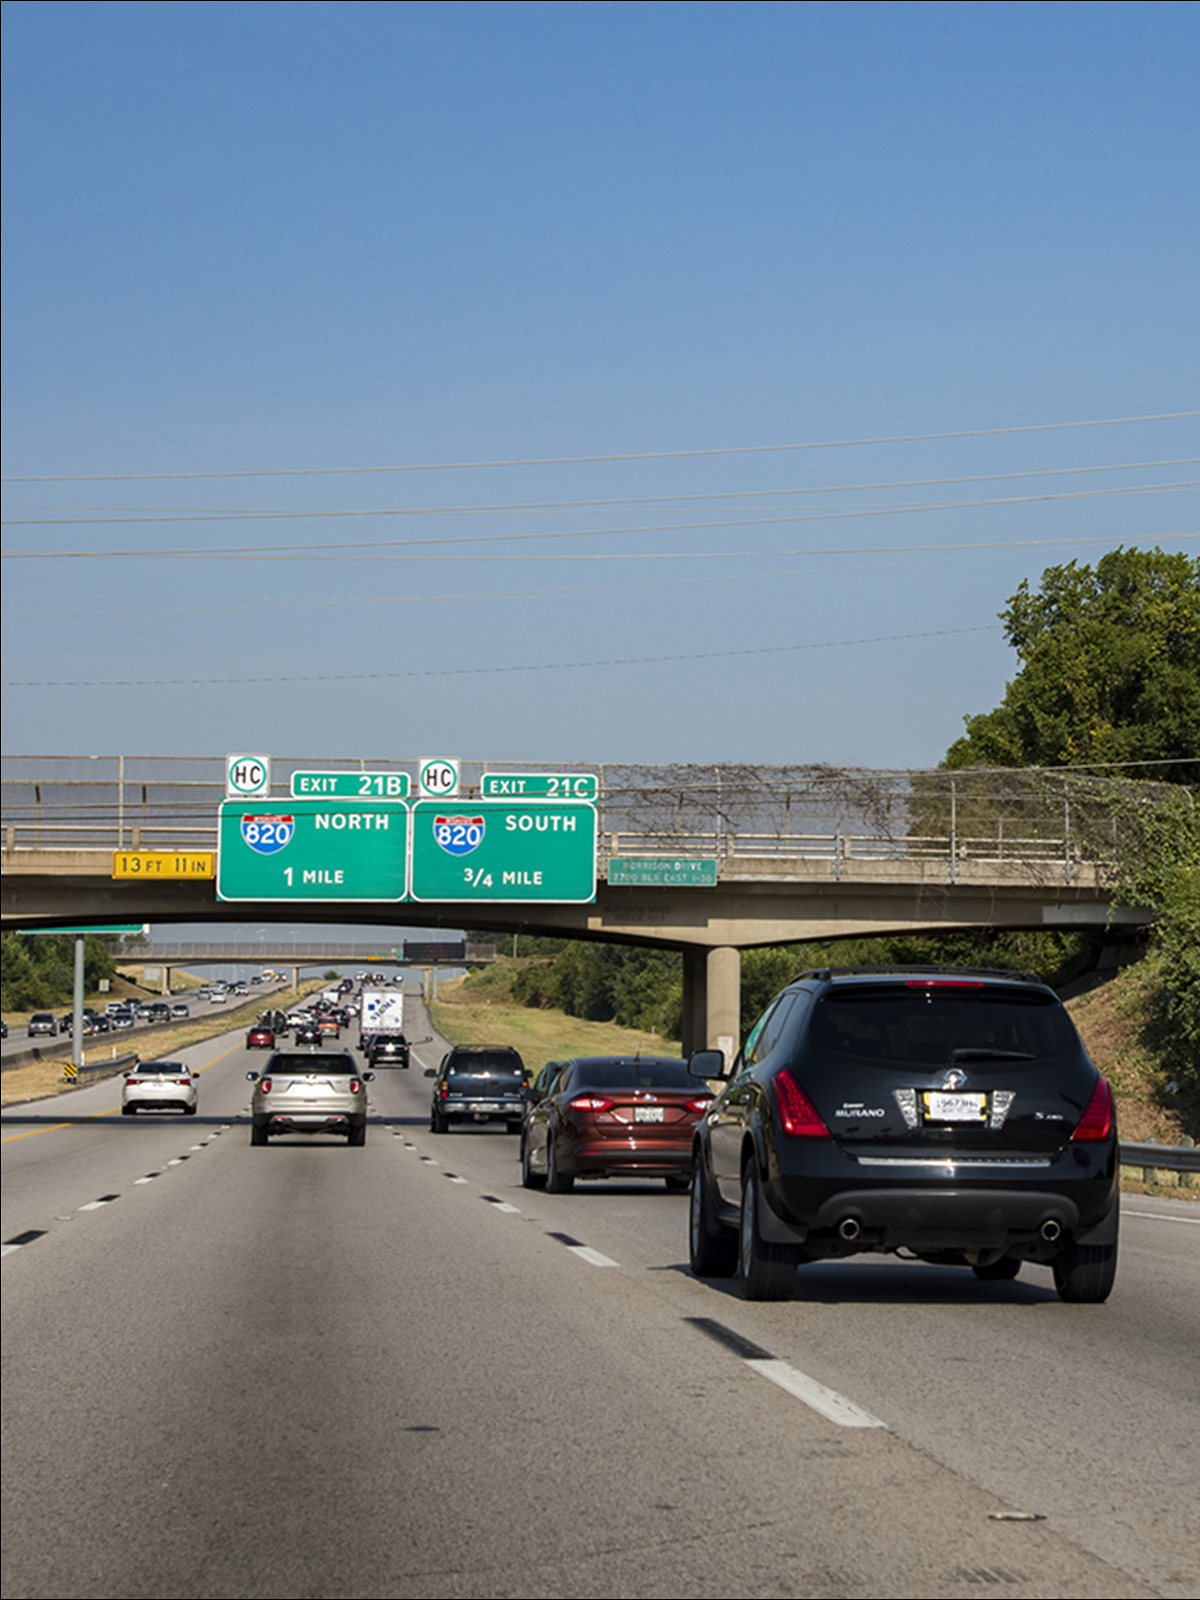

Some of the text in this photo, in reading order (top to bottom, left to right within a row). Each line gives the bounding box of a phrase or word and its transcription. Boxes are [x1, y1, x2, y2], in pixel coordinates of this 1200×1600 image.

[234, 765, 261, 785] HC
[426, 768, 452, 787] HC
[300, 776, 402, 795] EXIT 21B
[490, 778, 589, 797] EXIT 21C
[314, 813, 389, 830] NORTH
[505, 815, 577, 832] SOUTH
[245, 823, 290, 844] 820
[438, 825, 481, 846] 820
[122, 857, 206, 873] 13 FT 11 IN
[283, 866, 344, 887] 1 MILE
[463, 867, 543, 887] 3/4 MILE
[834, 1108, 885, 1118] MURANO
